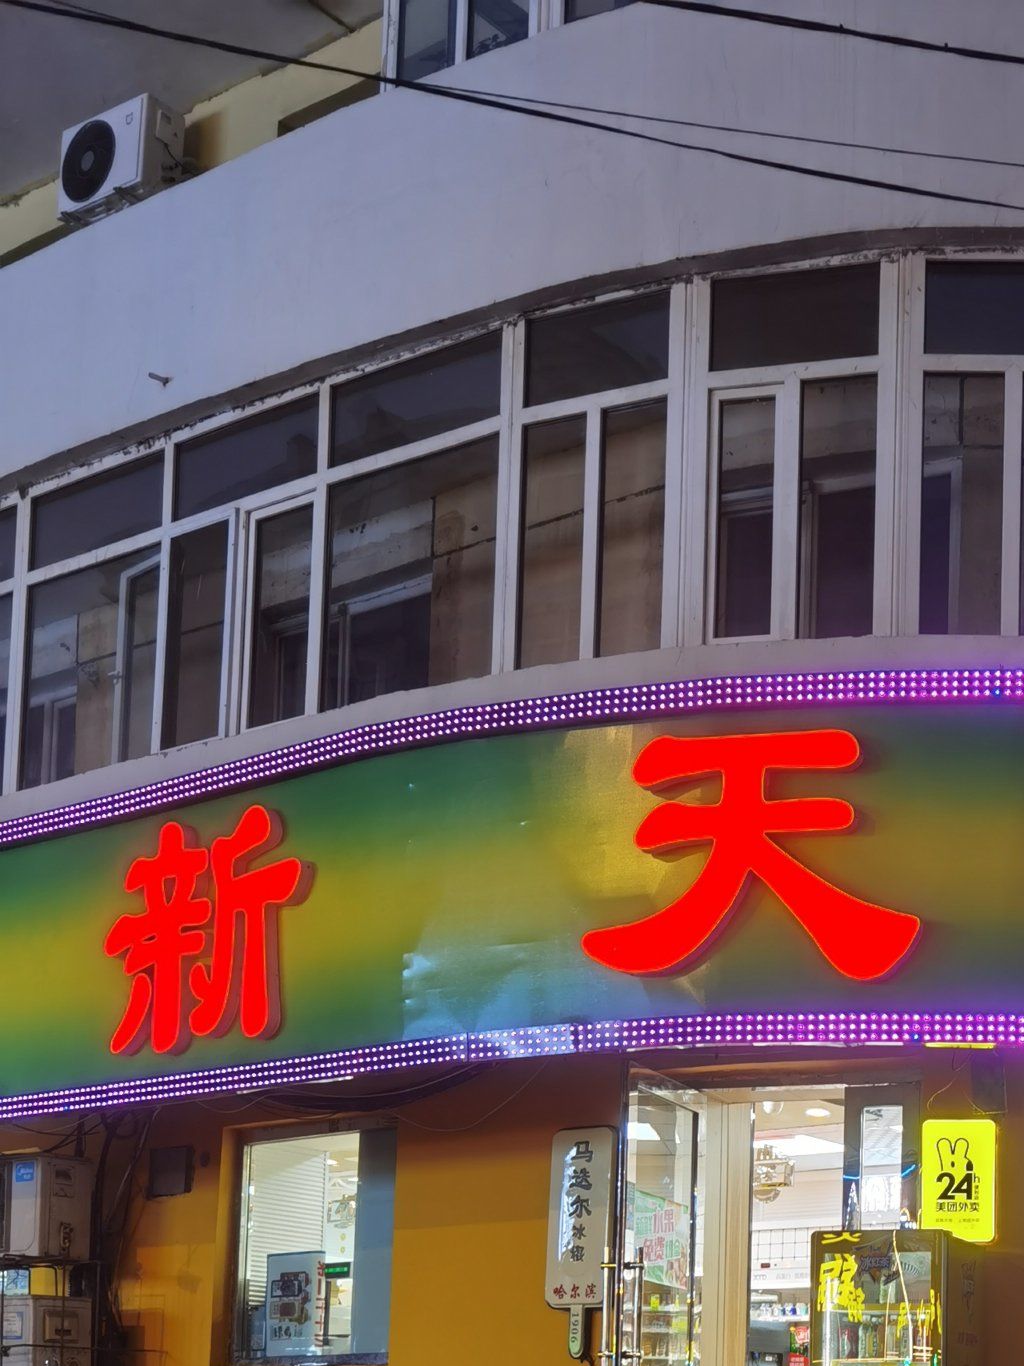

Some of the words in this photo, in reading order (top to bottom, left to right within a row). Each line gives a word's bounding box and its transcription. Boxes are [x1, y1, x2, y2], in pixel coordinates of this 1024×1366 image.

[936, 1202, 980, 1212] 美团外卖
[552, 1284, 597, 1300] 哈尔滨
[570, 1312, 580, 1344] 1906
